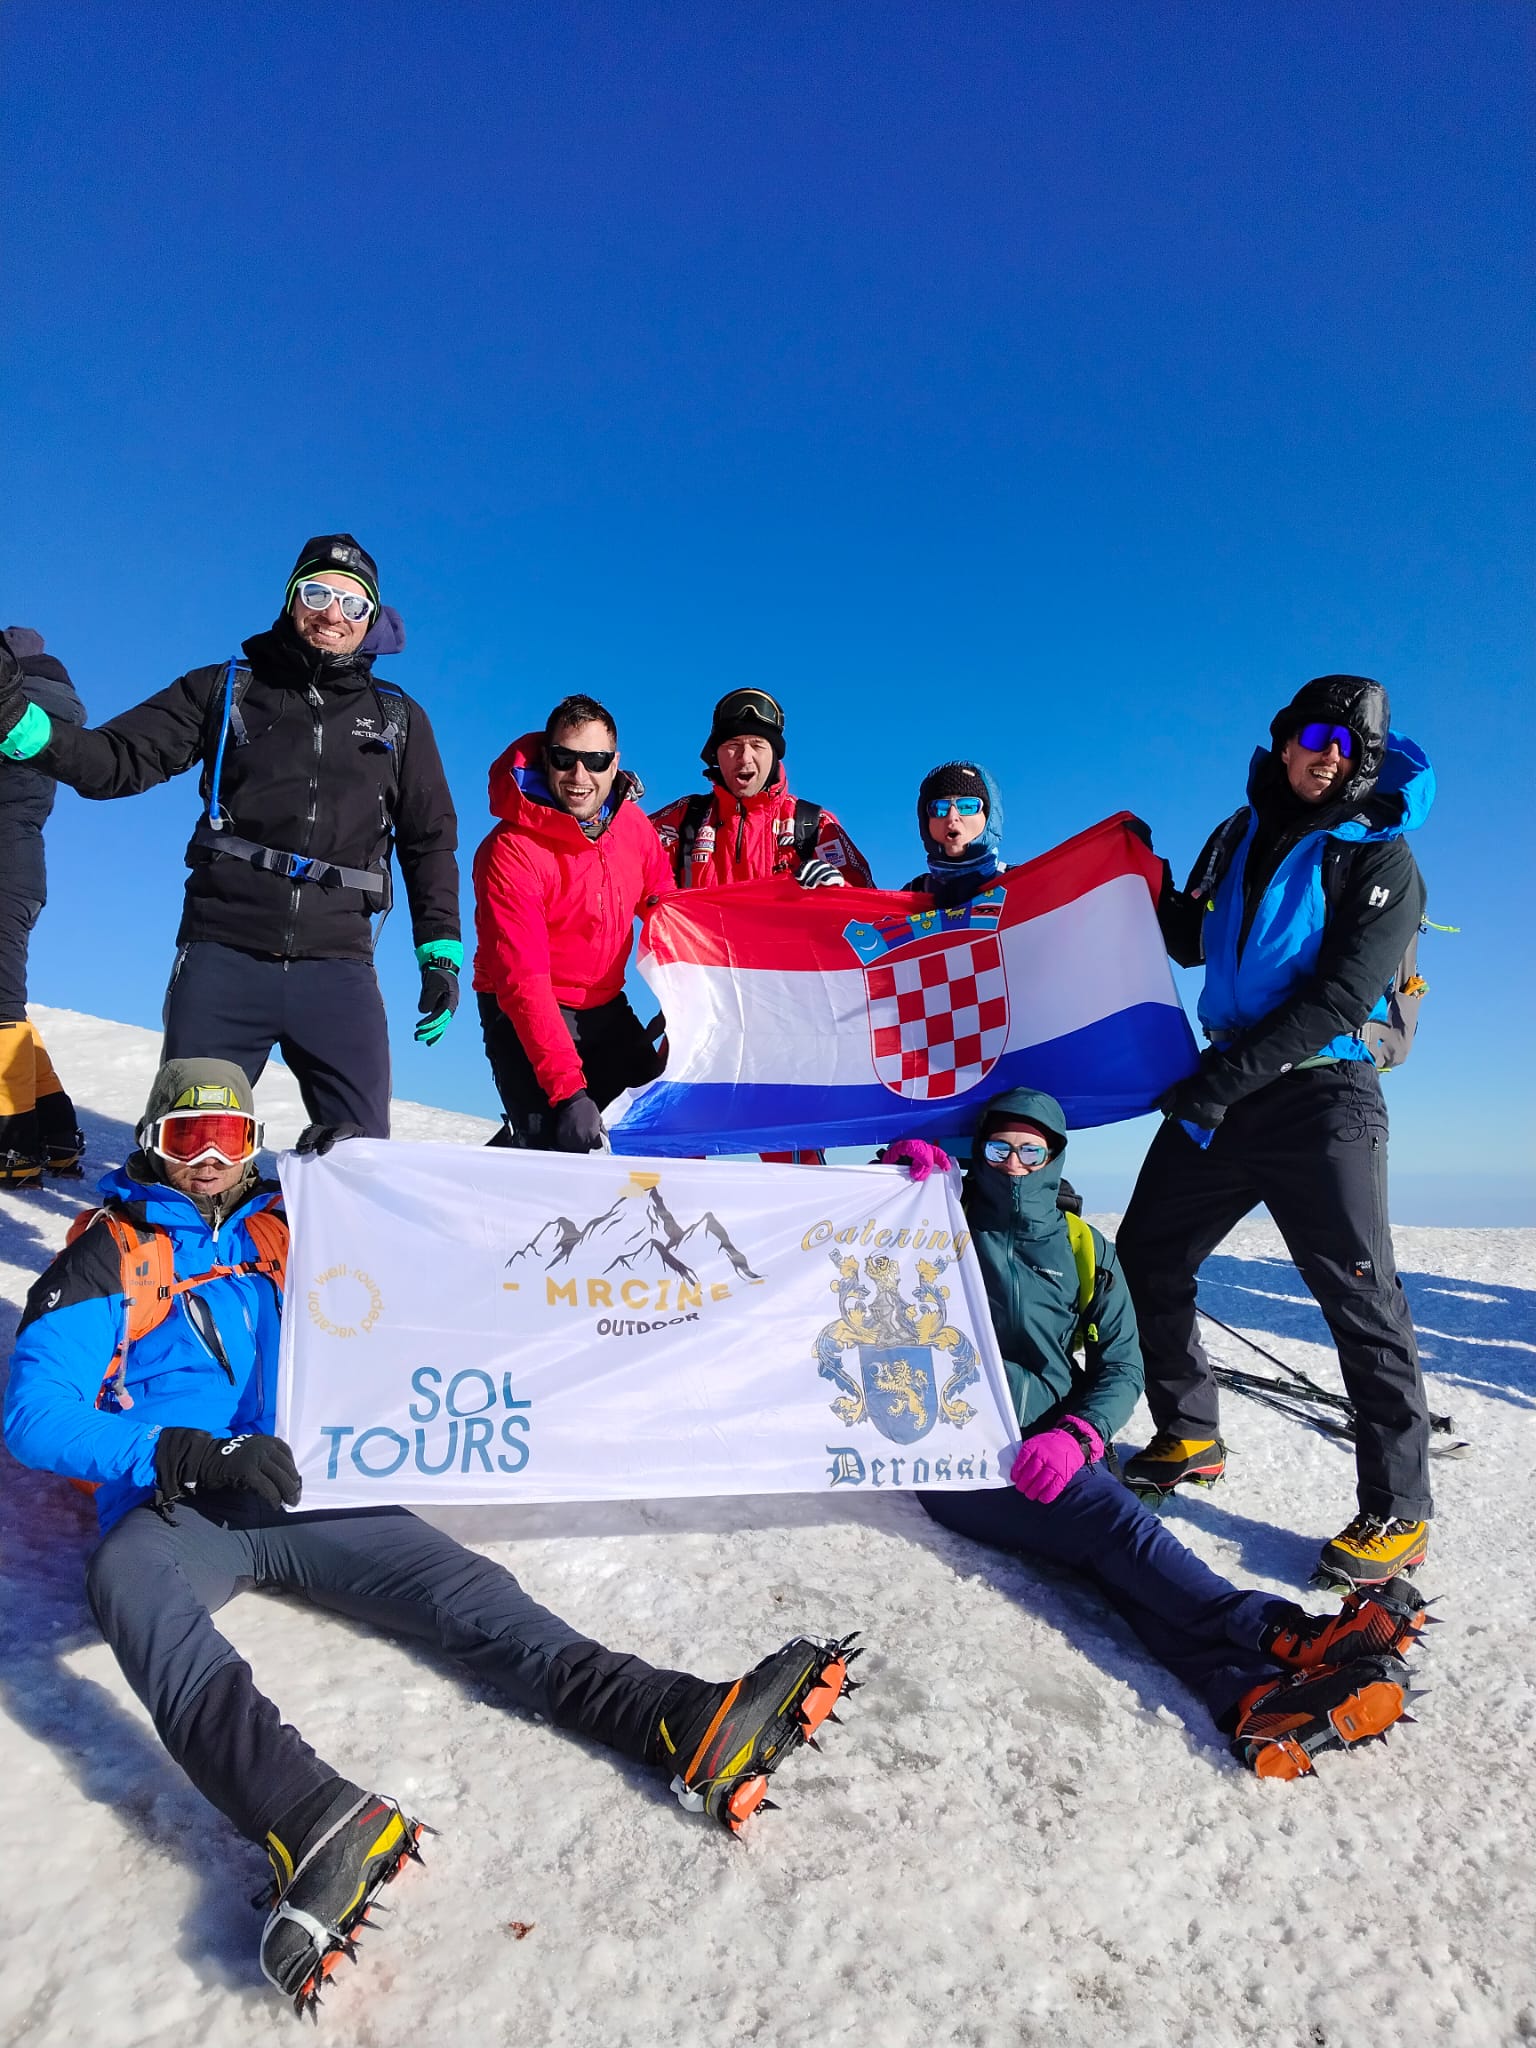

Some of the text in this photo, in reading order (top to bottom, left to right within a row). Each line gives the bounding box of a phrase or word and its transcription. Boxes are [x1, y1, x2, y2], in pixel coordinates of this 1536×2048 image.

[801, 1218, 973, 1263] Catering
[597, 1312, 701, 1336] OUTDOOR
[408, 1366, 532, 1423] SOL
[320, 1415, 531, 1480] TOURS
[825, 1444, 990, 1488] Derossi
